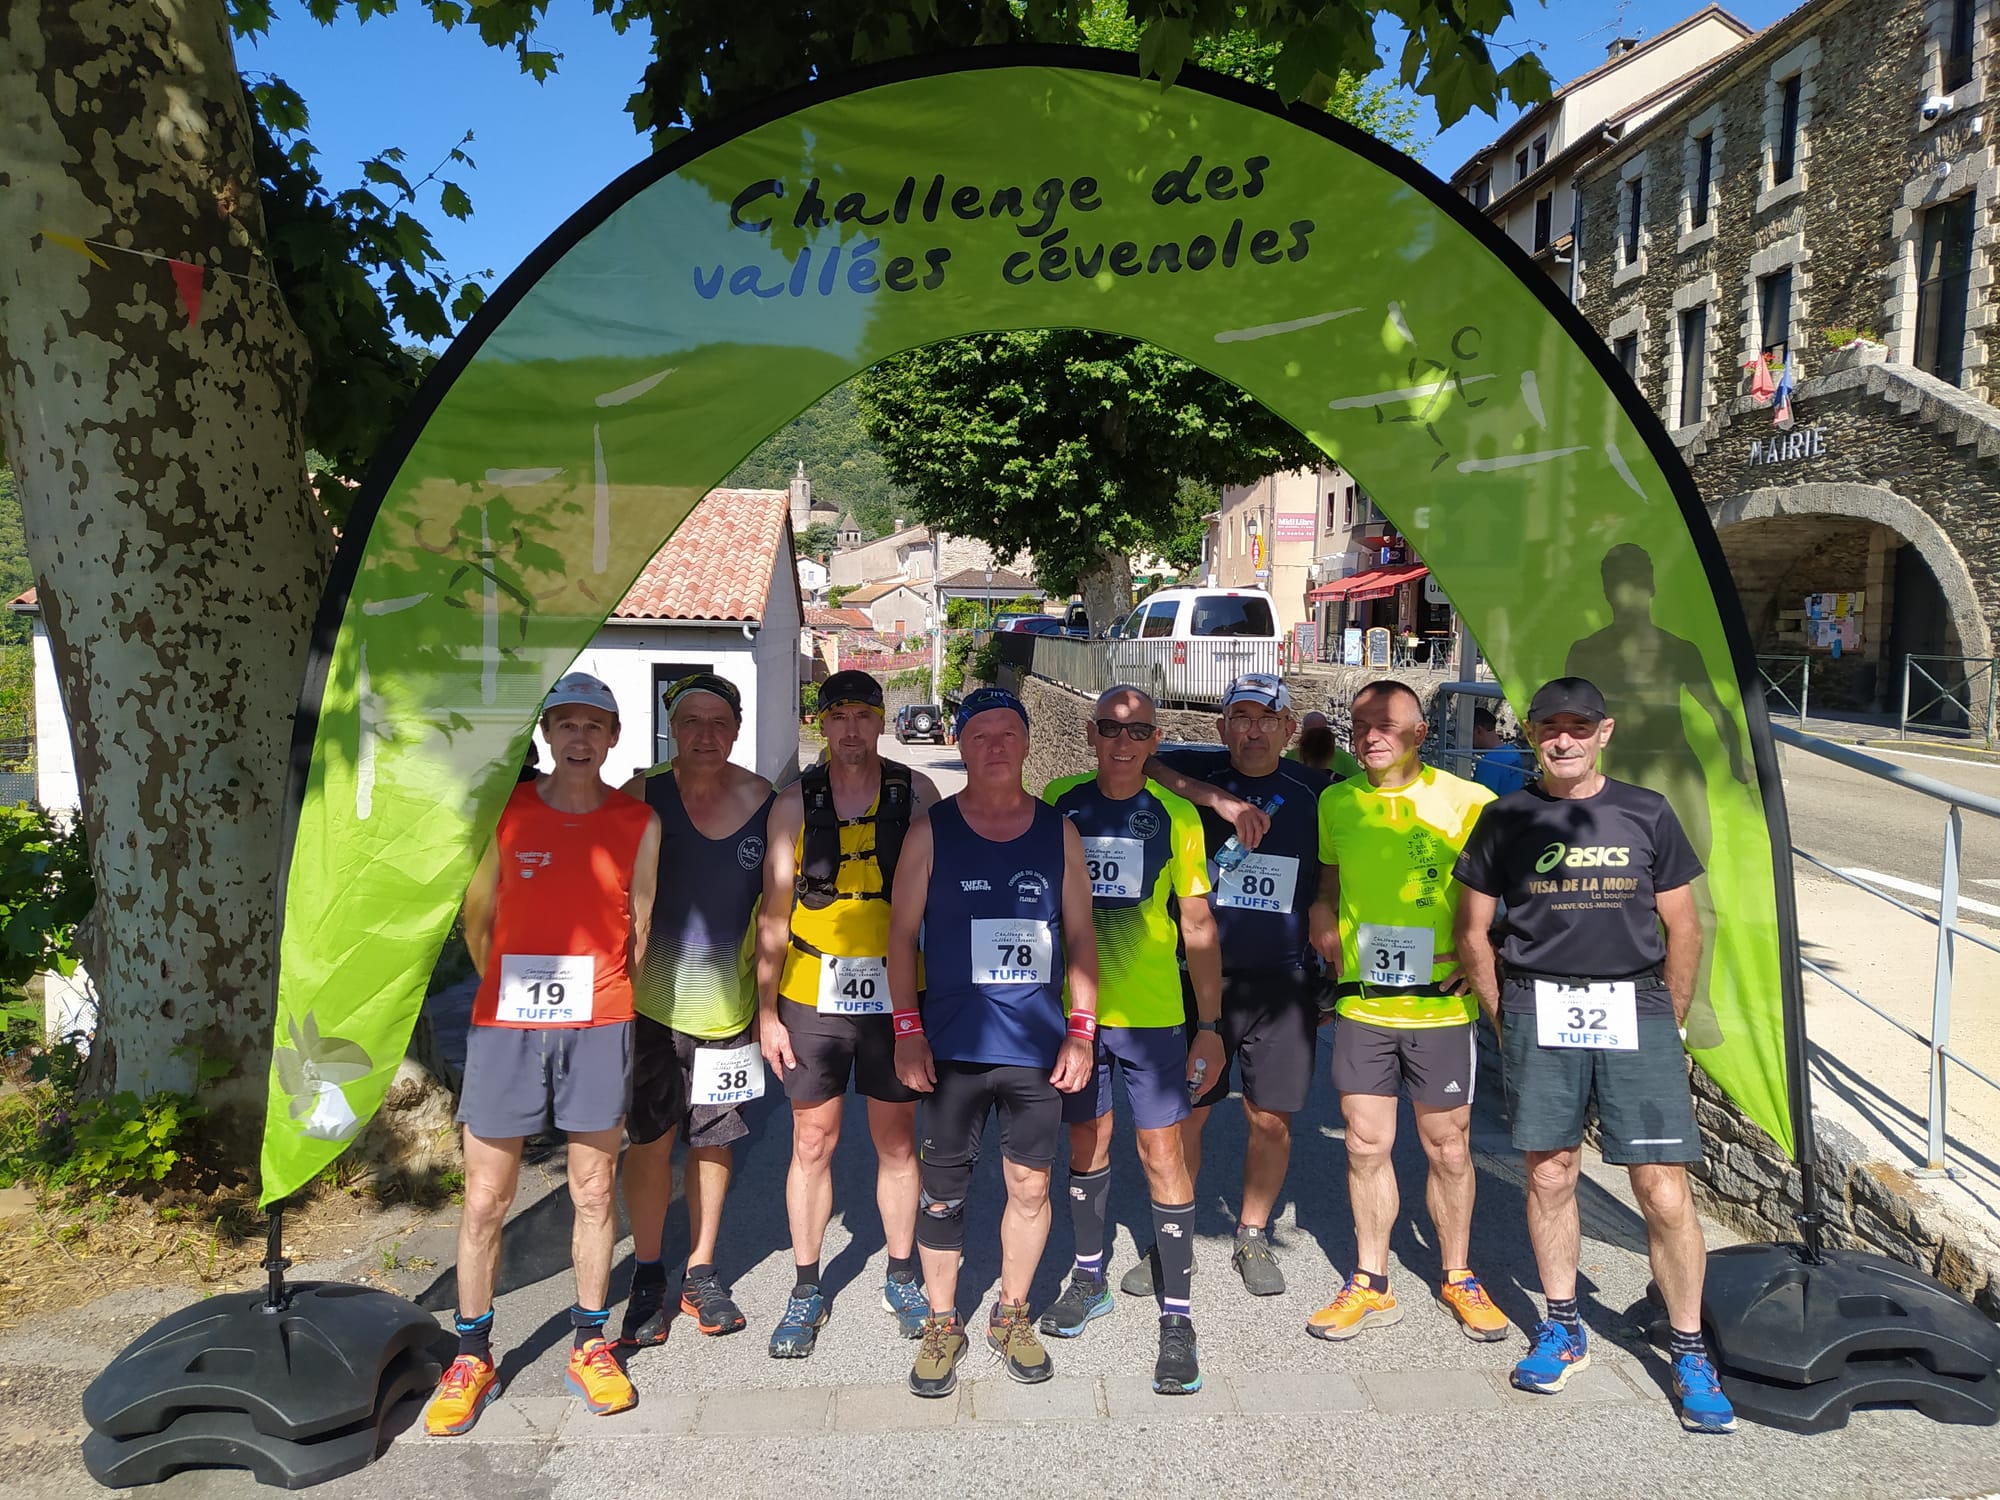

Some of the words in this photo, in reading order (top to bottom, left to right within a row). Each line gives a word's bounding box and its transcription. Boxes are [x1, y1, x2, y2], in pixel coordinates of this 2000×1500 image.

[730, 172, 1102, 237] Challenge
[1152, 155, 1270, 205] des
[694, 238, 951, 299] vallées
[1002, 218, 1315, 285] cévenoles
[1749, 427, 1827, 466] MAIRIE
[1565, 846, 1630, 867] asics
[1086, 860, 1119, 881] 30
[1242, 875, 1275, 897] 80
[1529, 880, 1558, 894] VISA
[1562, 879, 1579, 892] DE
[1582, 878, 1599, 891] LA
[1602, 877, 1638, 891] MODE
[1233, 896, 1280, 910] TUFF'S
[997, 944, 1032, 967] 78
[1375, 948, 1405, 971] 31
[989, 969, 1037, 980] TUFF'S
[1370, 970, 1416, 983] TUFF'S
[527, 982, 565, 1005] 19
[842, 978, 875, 999] 40
[516, 1007, 573, 1019] TUFF'S
[834, 1000, 884, 1011] TUFF'S
[1567, 1006, 1608, 1030] 32
[1557, 1032, 1618, 1045] TUFF'S
[717, 1070, 747, 1090] 38
[708, 1088, 753, 1102] TUFF'S
